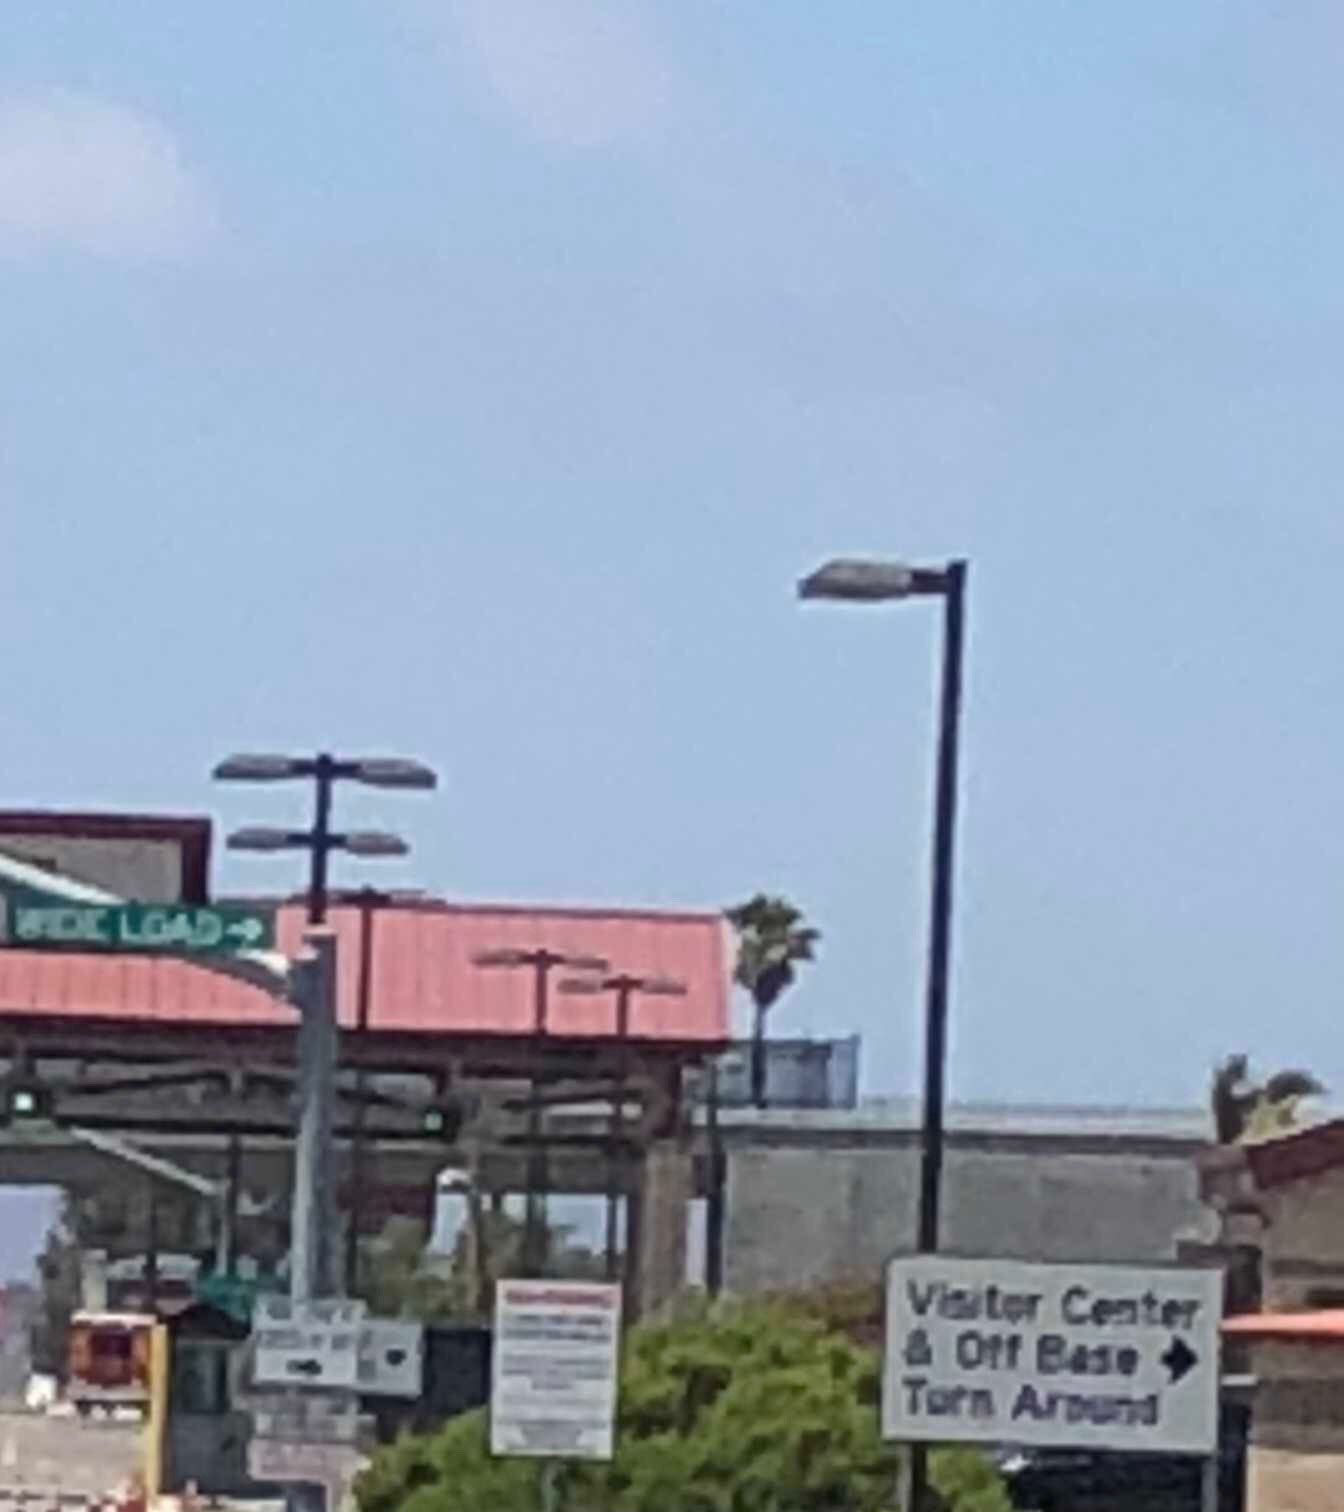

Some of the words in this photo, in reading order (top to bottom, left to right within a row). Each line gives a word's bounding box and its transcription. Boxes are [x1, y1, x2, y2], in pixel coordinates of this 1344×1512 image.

[120, 908, 224, 946] LOAD
[906, 1280, 1042, 1323] Visitor
[1062, 1284, 1201, 1330] Center
[904, 1330, 933, 1367] &
[956, 1330, 1021, 1370] Off
[1036, 1334, 1139, 1377] Base
[902, 1378, 996, 1417] Turn
[1011, 1385, 1158, 1427] Around
